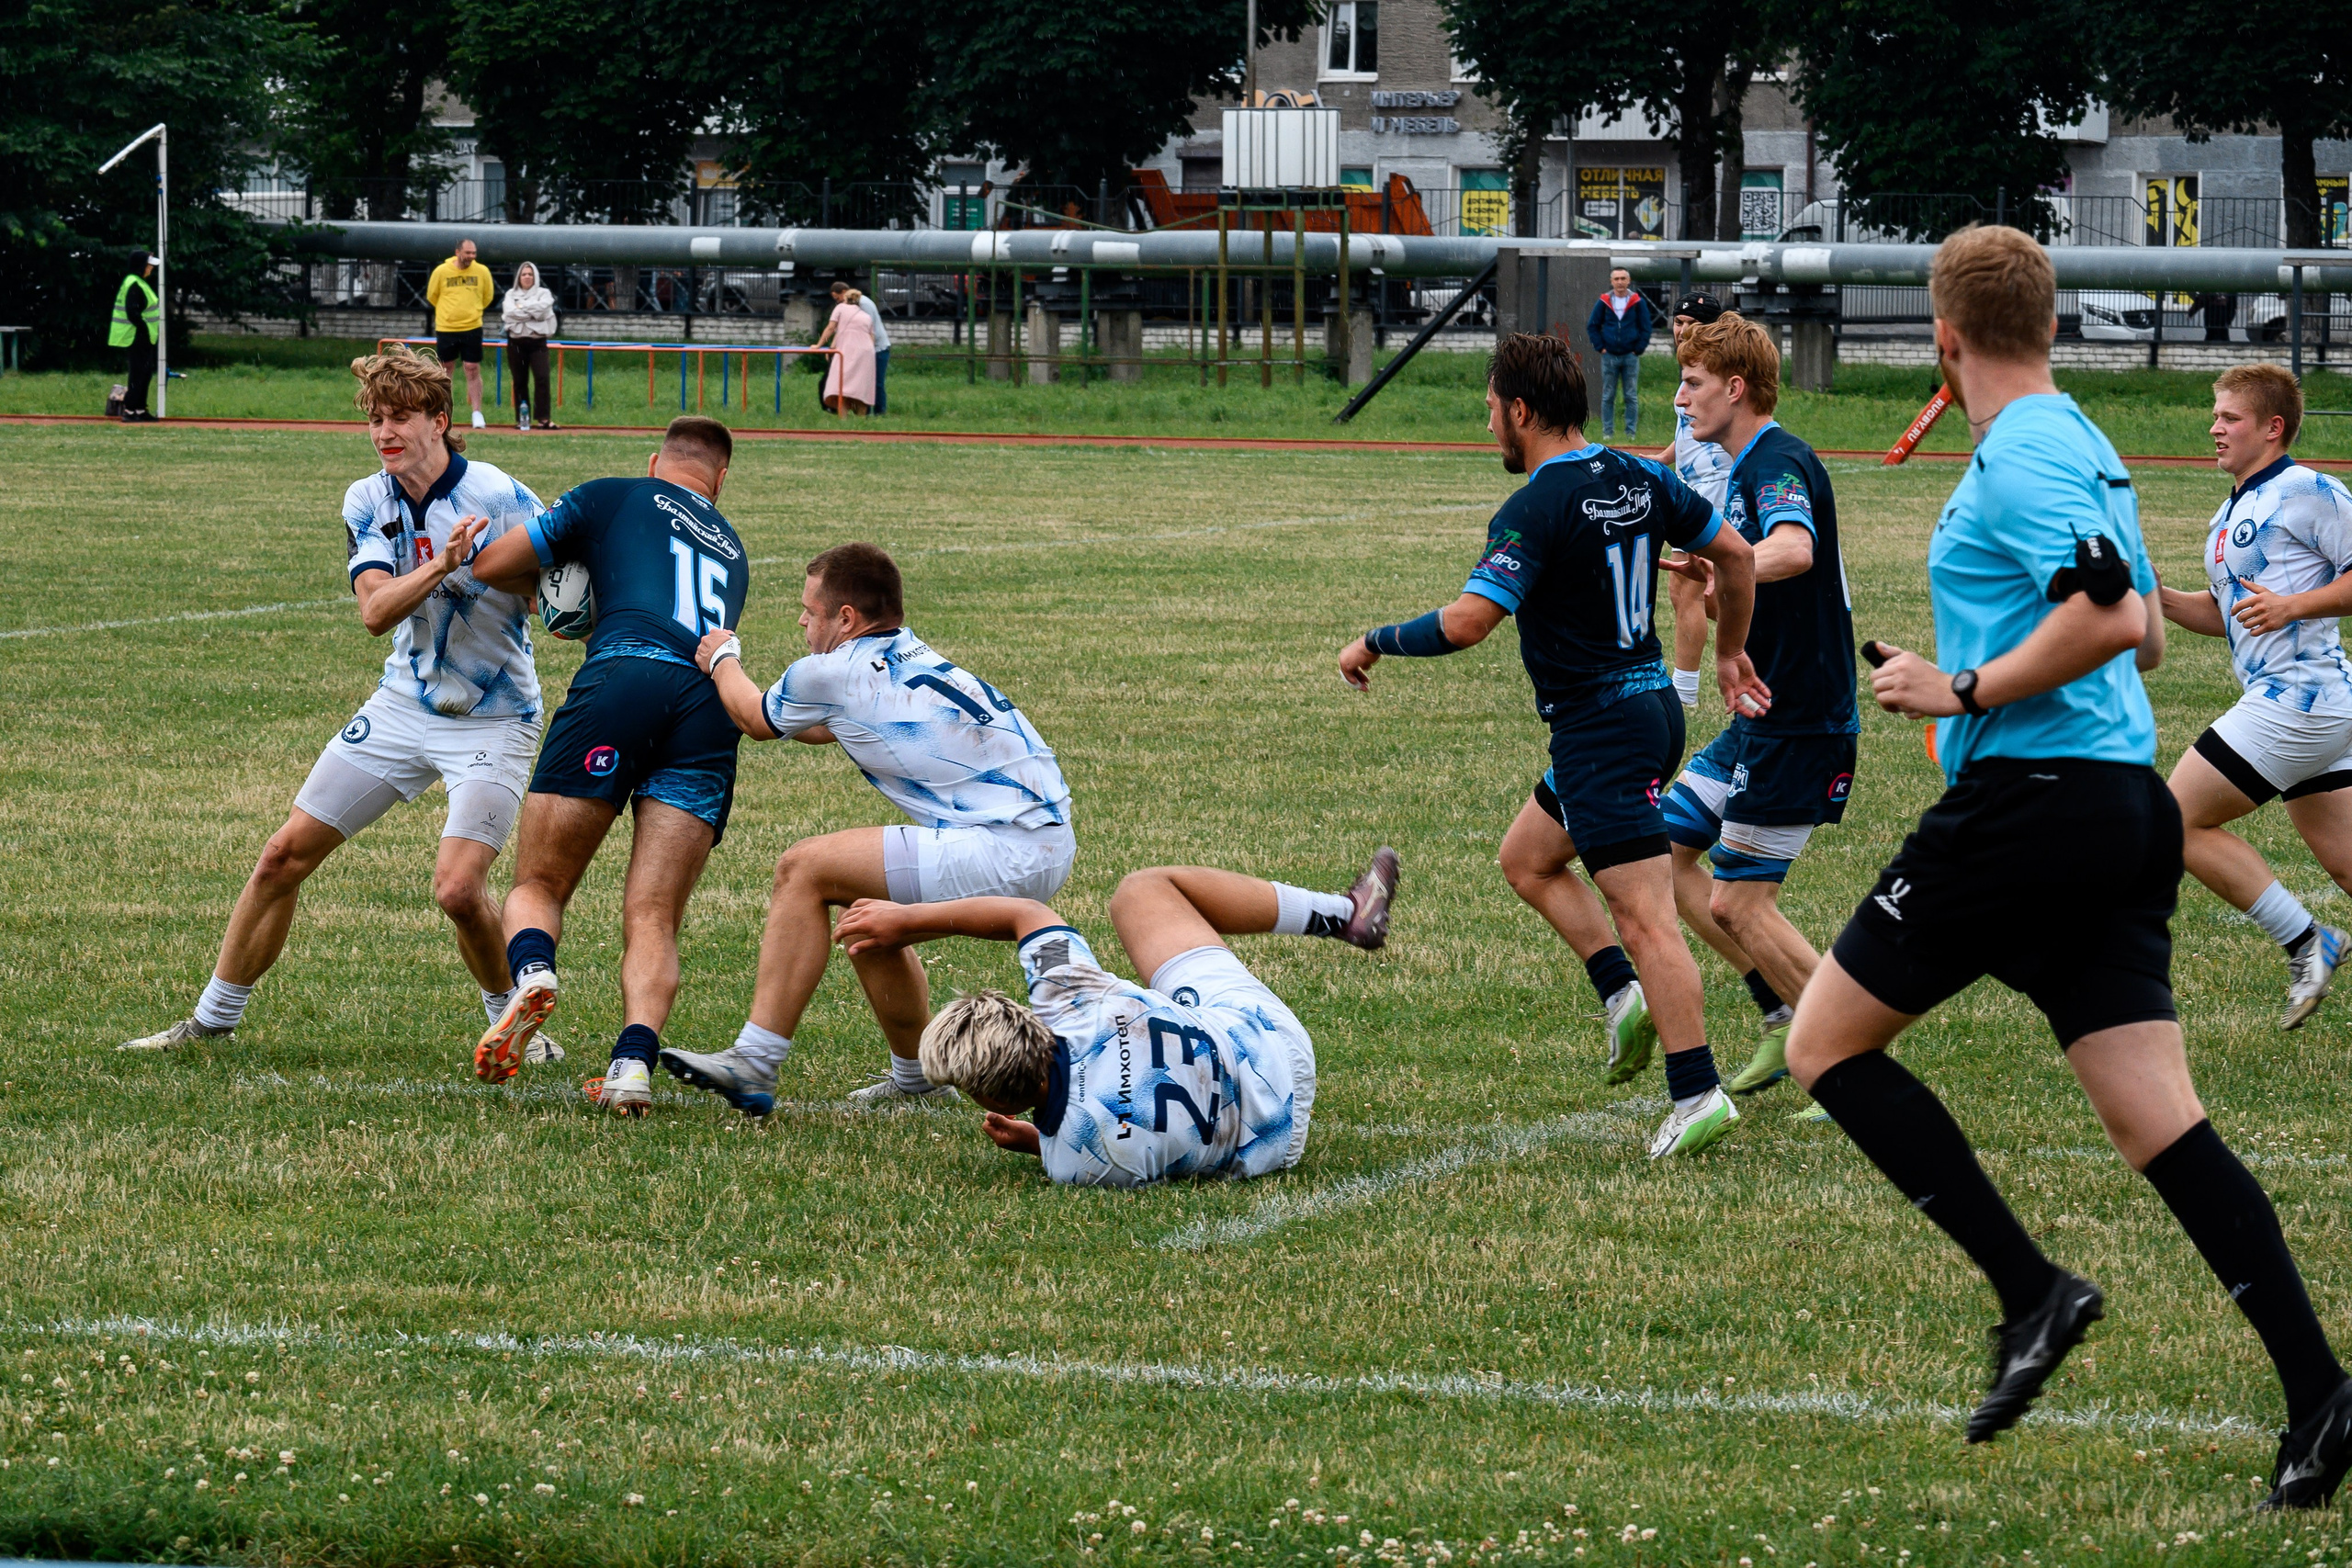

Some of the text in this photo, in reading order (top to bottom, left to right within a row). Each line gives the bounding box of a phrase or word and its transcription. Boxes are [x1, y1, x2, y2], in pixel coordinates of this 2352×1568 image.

[1371, 91, 1461, 107] ИНТЕРЬЕР
[1389, 117, 1460, 133] МЕБЕЛЬ
[1580, 168, 1664, 182] ОТЛИЧНАЯ
[1906, 397, 1946, 443] RUGBY.RU
[1787, 492, 1811, 509] ПРО
[1490, 553, 1521, 571] ПРО
[670, 536, 729, 637] 15
[1605, 533, 1652, 649] 14
[1148, 1017, 1221, 1145] 23
